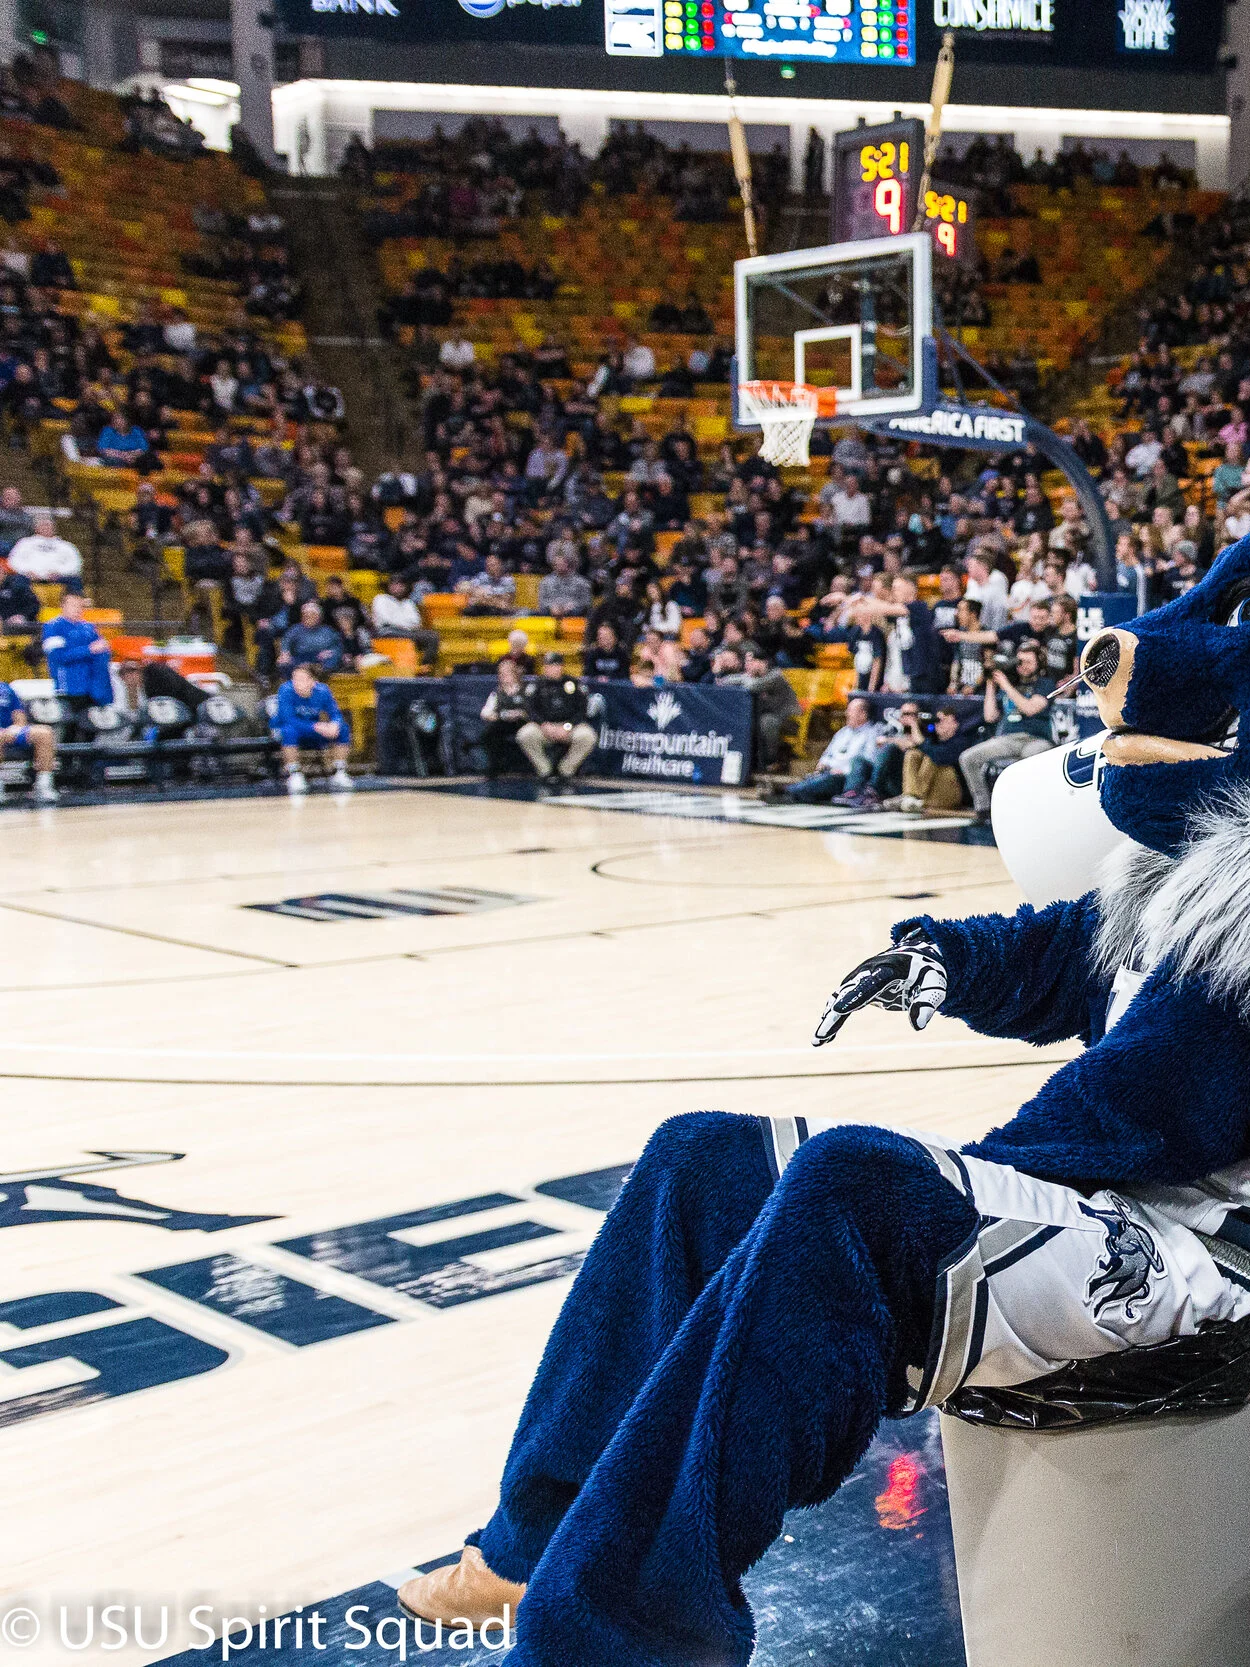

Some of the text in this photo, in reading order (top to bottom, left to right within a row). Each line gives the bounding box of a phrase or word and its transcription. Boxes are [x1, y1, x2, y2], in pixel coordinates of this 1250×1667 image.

[1125, 30, 1169, 50] LIFE
[875, 178, 903, 235] 9
[936, 221, 957, 256] 9
[974, 415, 1026, 442] FIRST
[598, 722, 732, 759] Intermountain
[621, 752, 695, 778] Healthcare
